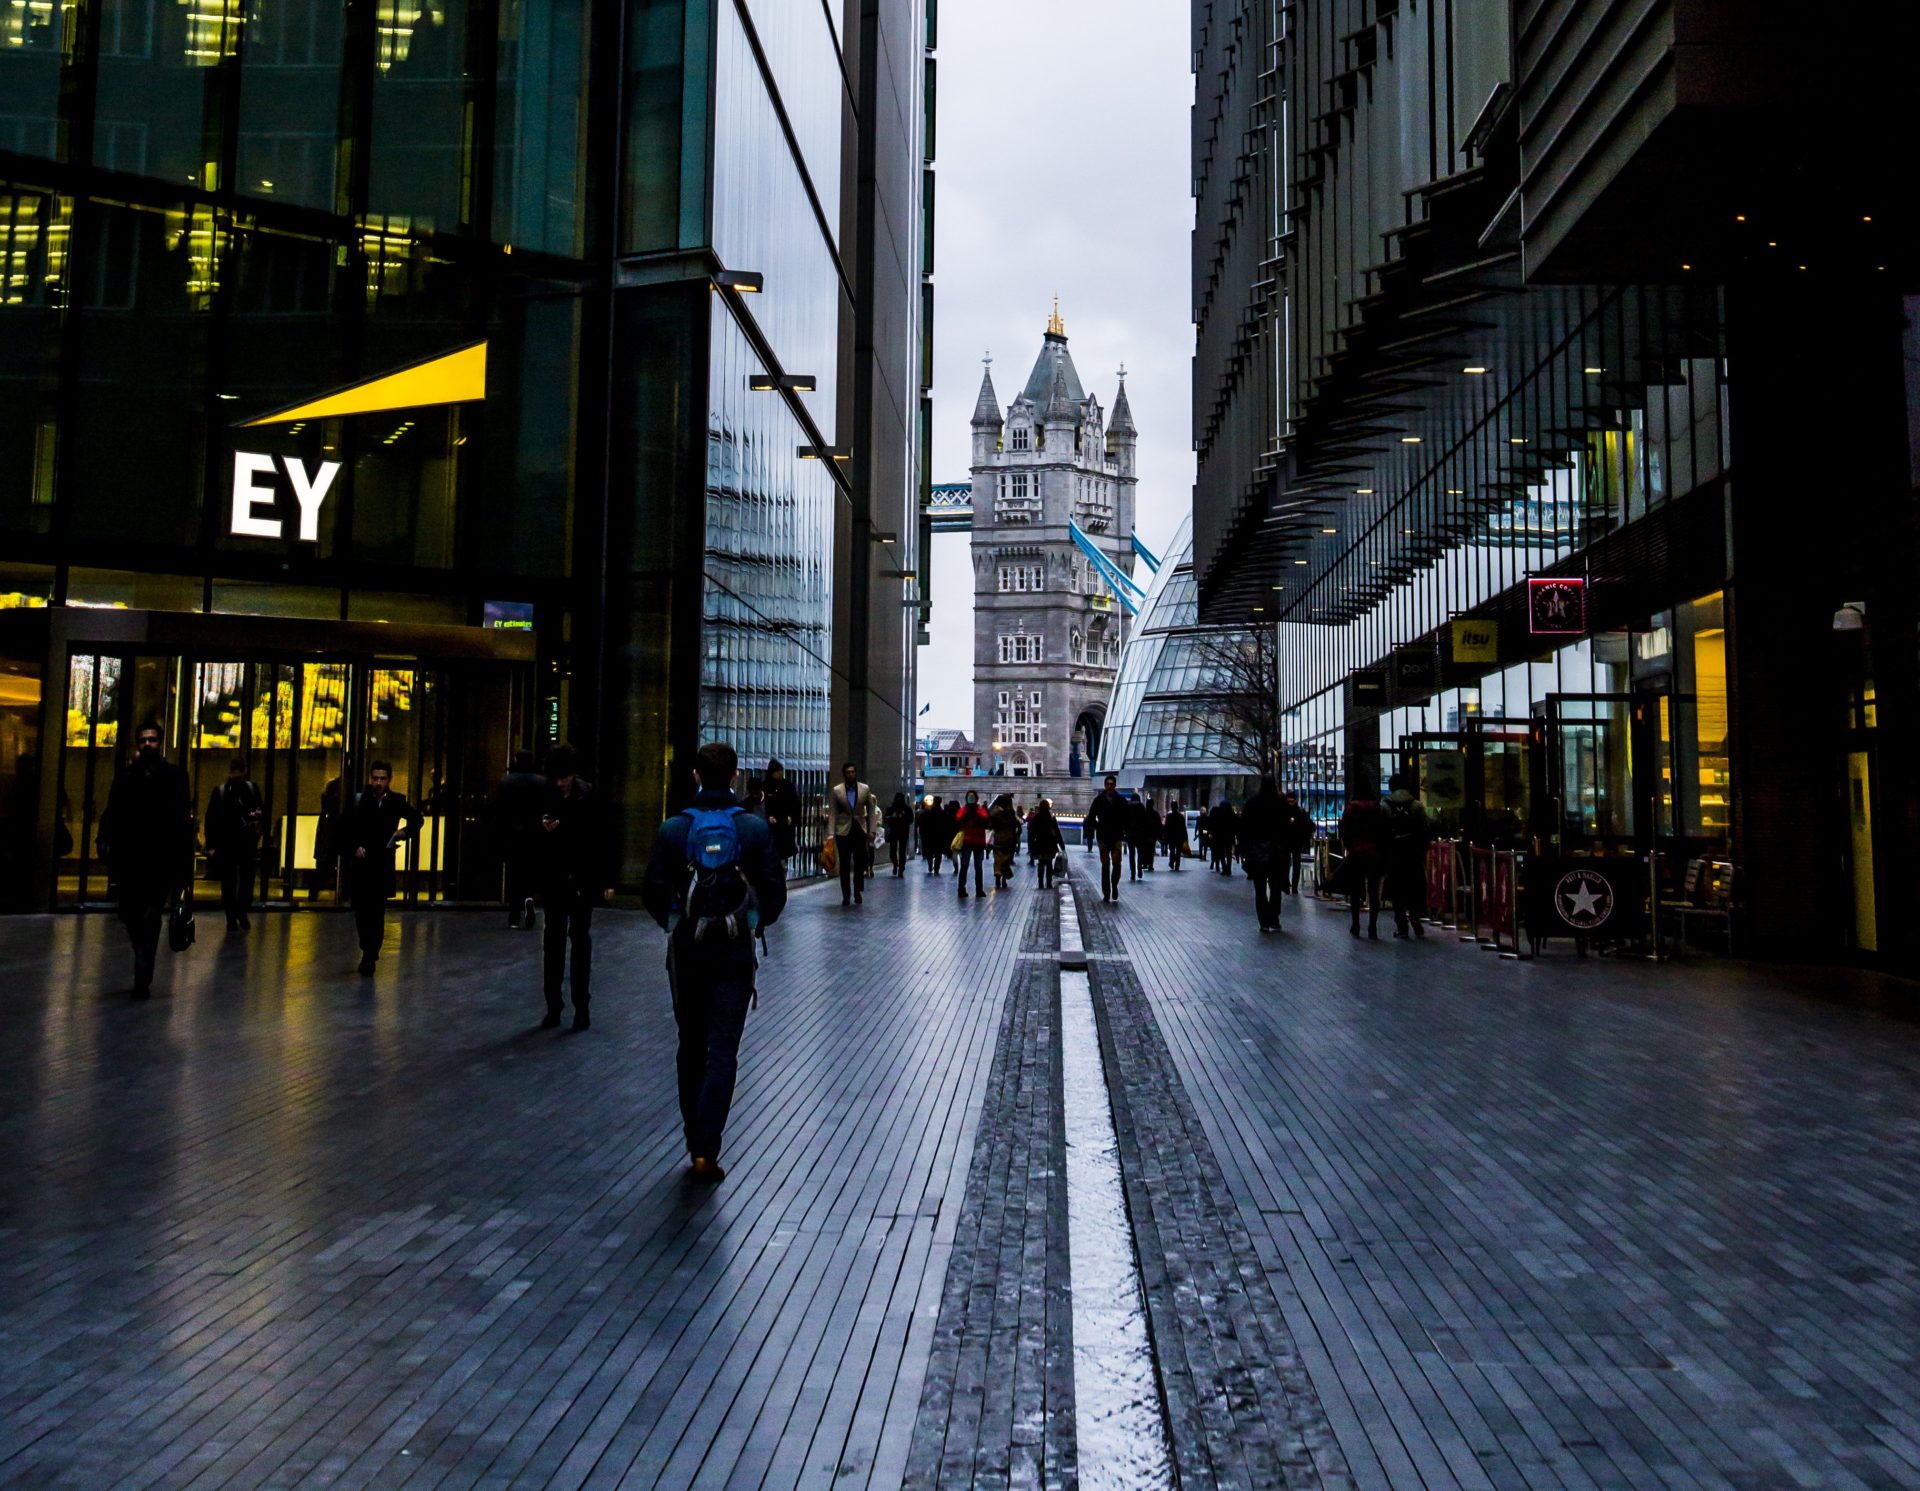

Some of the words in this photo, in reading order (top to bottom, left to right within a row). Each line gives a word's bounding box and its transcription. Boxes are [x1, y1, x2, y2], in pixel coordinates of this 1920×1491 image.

[231, 450, 342, 541] EY
[494, 619, 503, 628] EY
[1462, 631, 1490, 645] itsu
